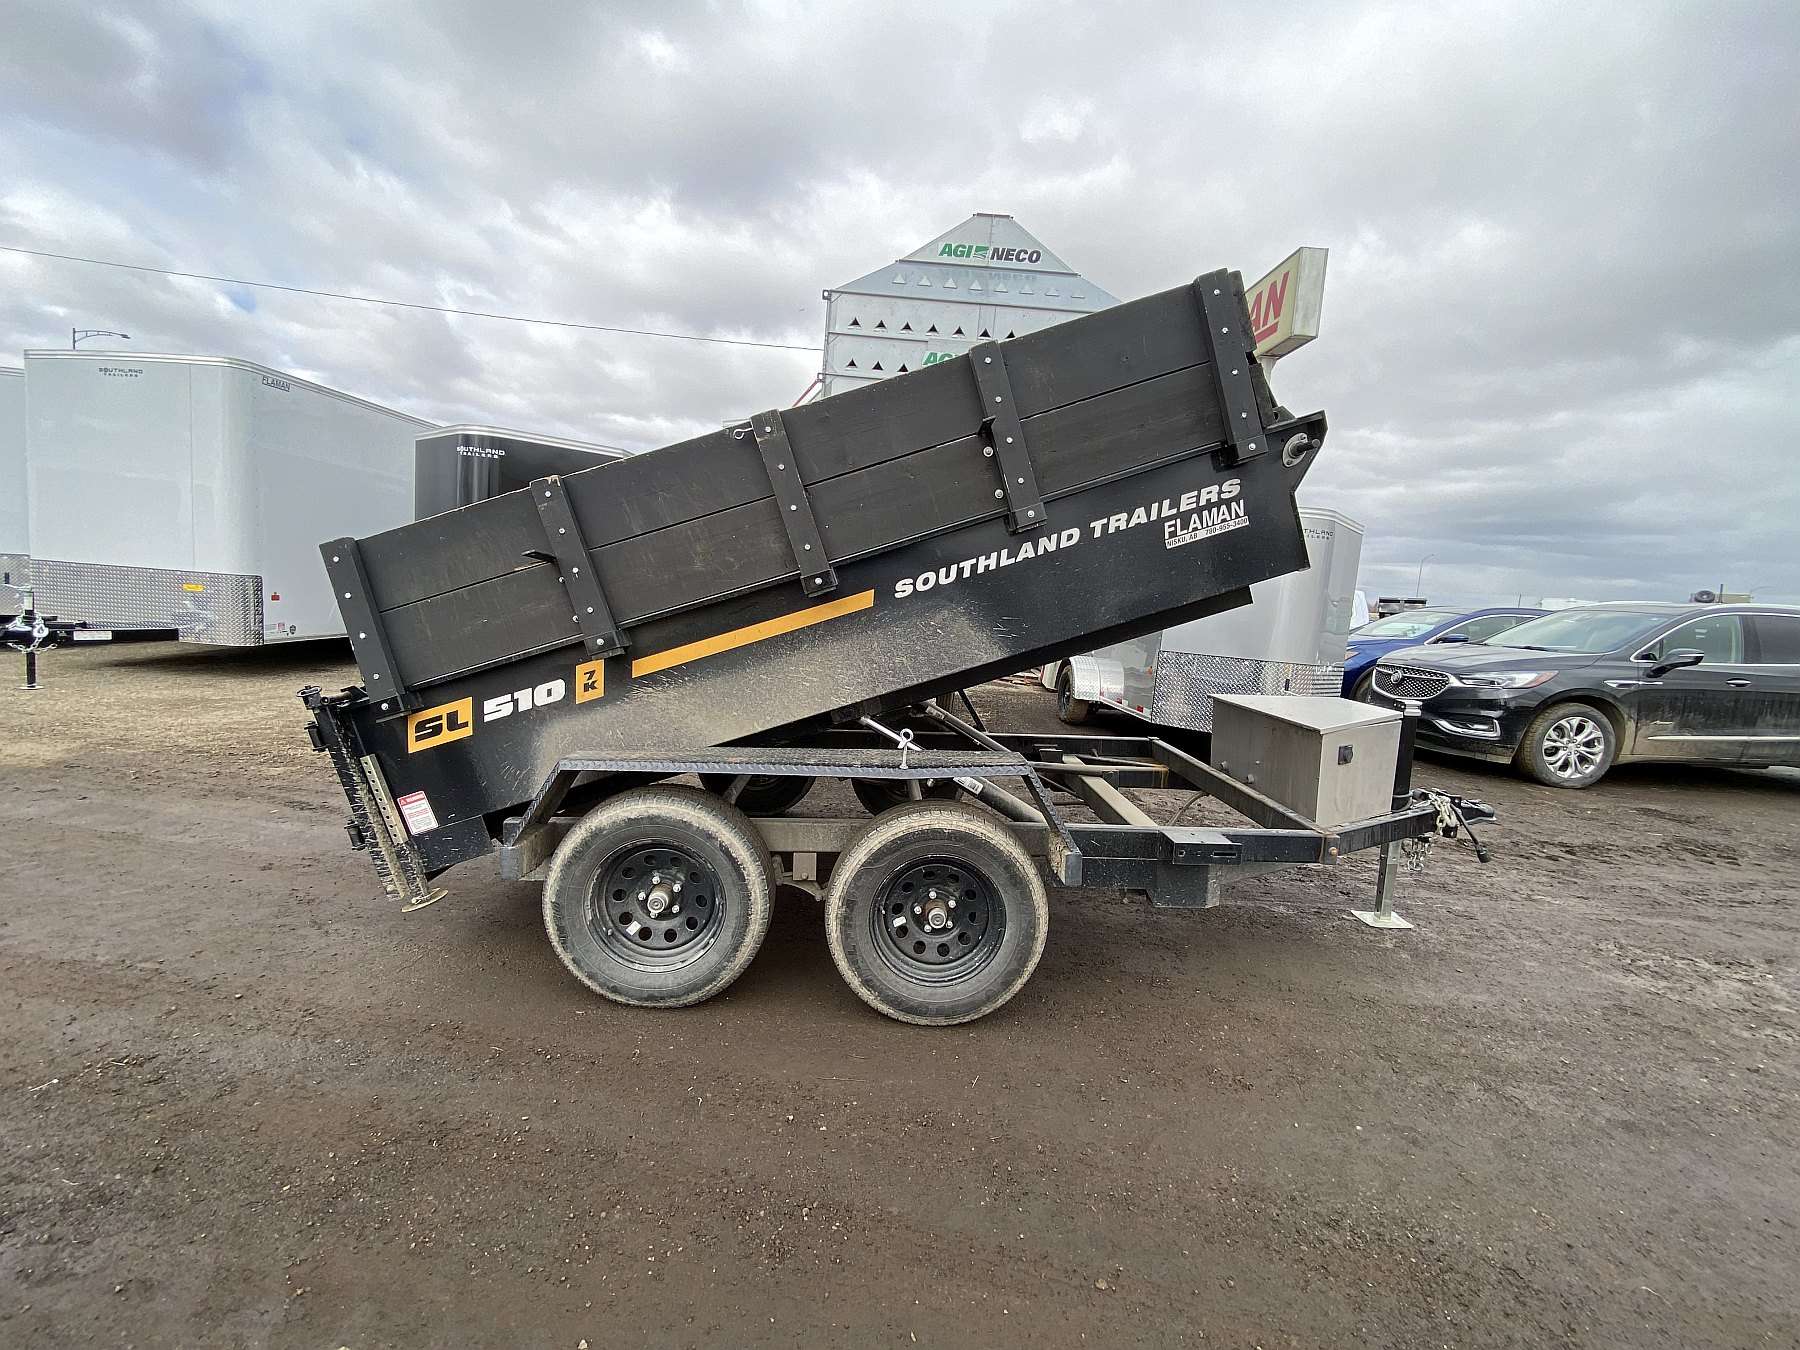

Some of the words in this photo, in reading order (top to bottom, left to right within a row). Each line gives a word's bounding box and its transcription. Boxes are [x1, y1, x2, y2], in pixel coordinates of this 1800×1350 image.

[938, 243, 973, 259] AGI
[990, 247, 1041, 264] NECO
[456, 446, 506, 456] SOUTHLAND
[1164, 499, 1245, 540] FLAMAN
[894, 527, 1081, 600] SOUTHLAND
[1089, 478, 1242, 538] TRAILERS
[1166, 535, 1188, 547] NISKU,
[1188, 532, 1198, 541] AB
[583, 669, 597, 681] 7
[583, 680, 598, 693] K
[414, 709, 469, 743] SL
[483, 678, 566, 723] 510
